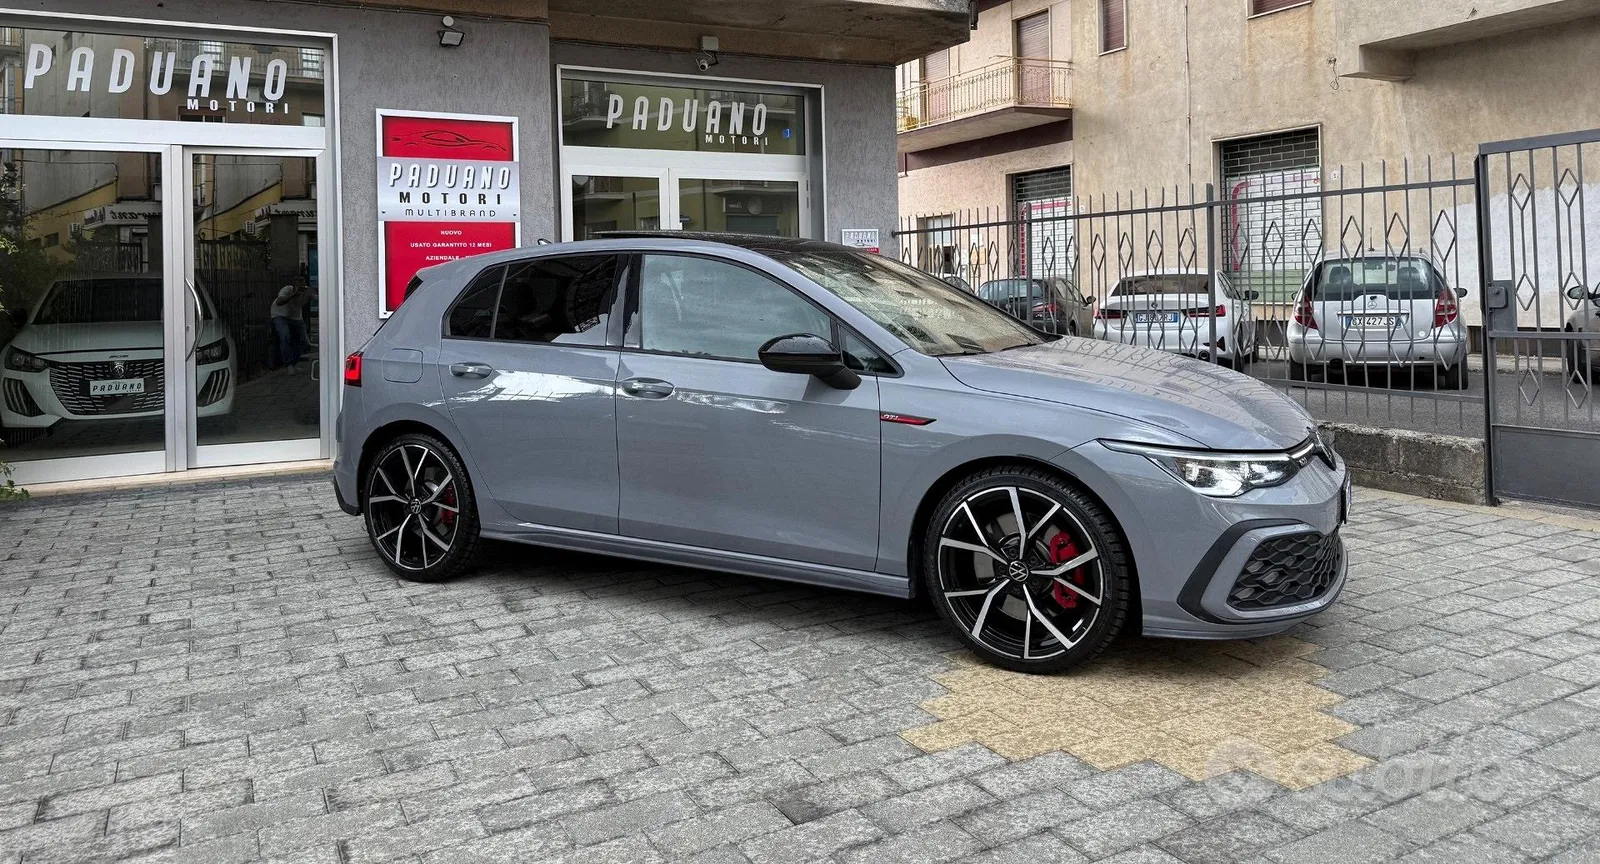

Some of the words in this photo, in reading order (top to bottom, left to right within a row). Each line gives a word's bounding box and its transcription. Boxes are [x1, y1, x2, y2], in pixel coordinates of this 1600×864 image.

[24, 43, 288, 101] PADUANO
[187, 98, 289, 114] MOTORI
[606, 93, 767, 136] PADUANO
[705, 134, 768, 146] MOTORI
[389, 162, 511, 190] PADUANO
[399, 191, 501, 205] MOTORI
[405, 208, 497, 218] MULTIBRAND
[92, 382, 142, 392] PADUANO
